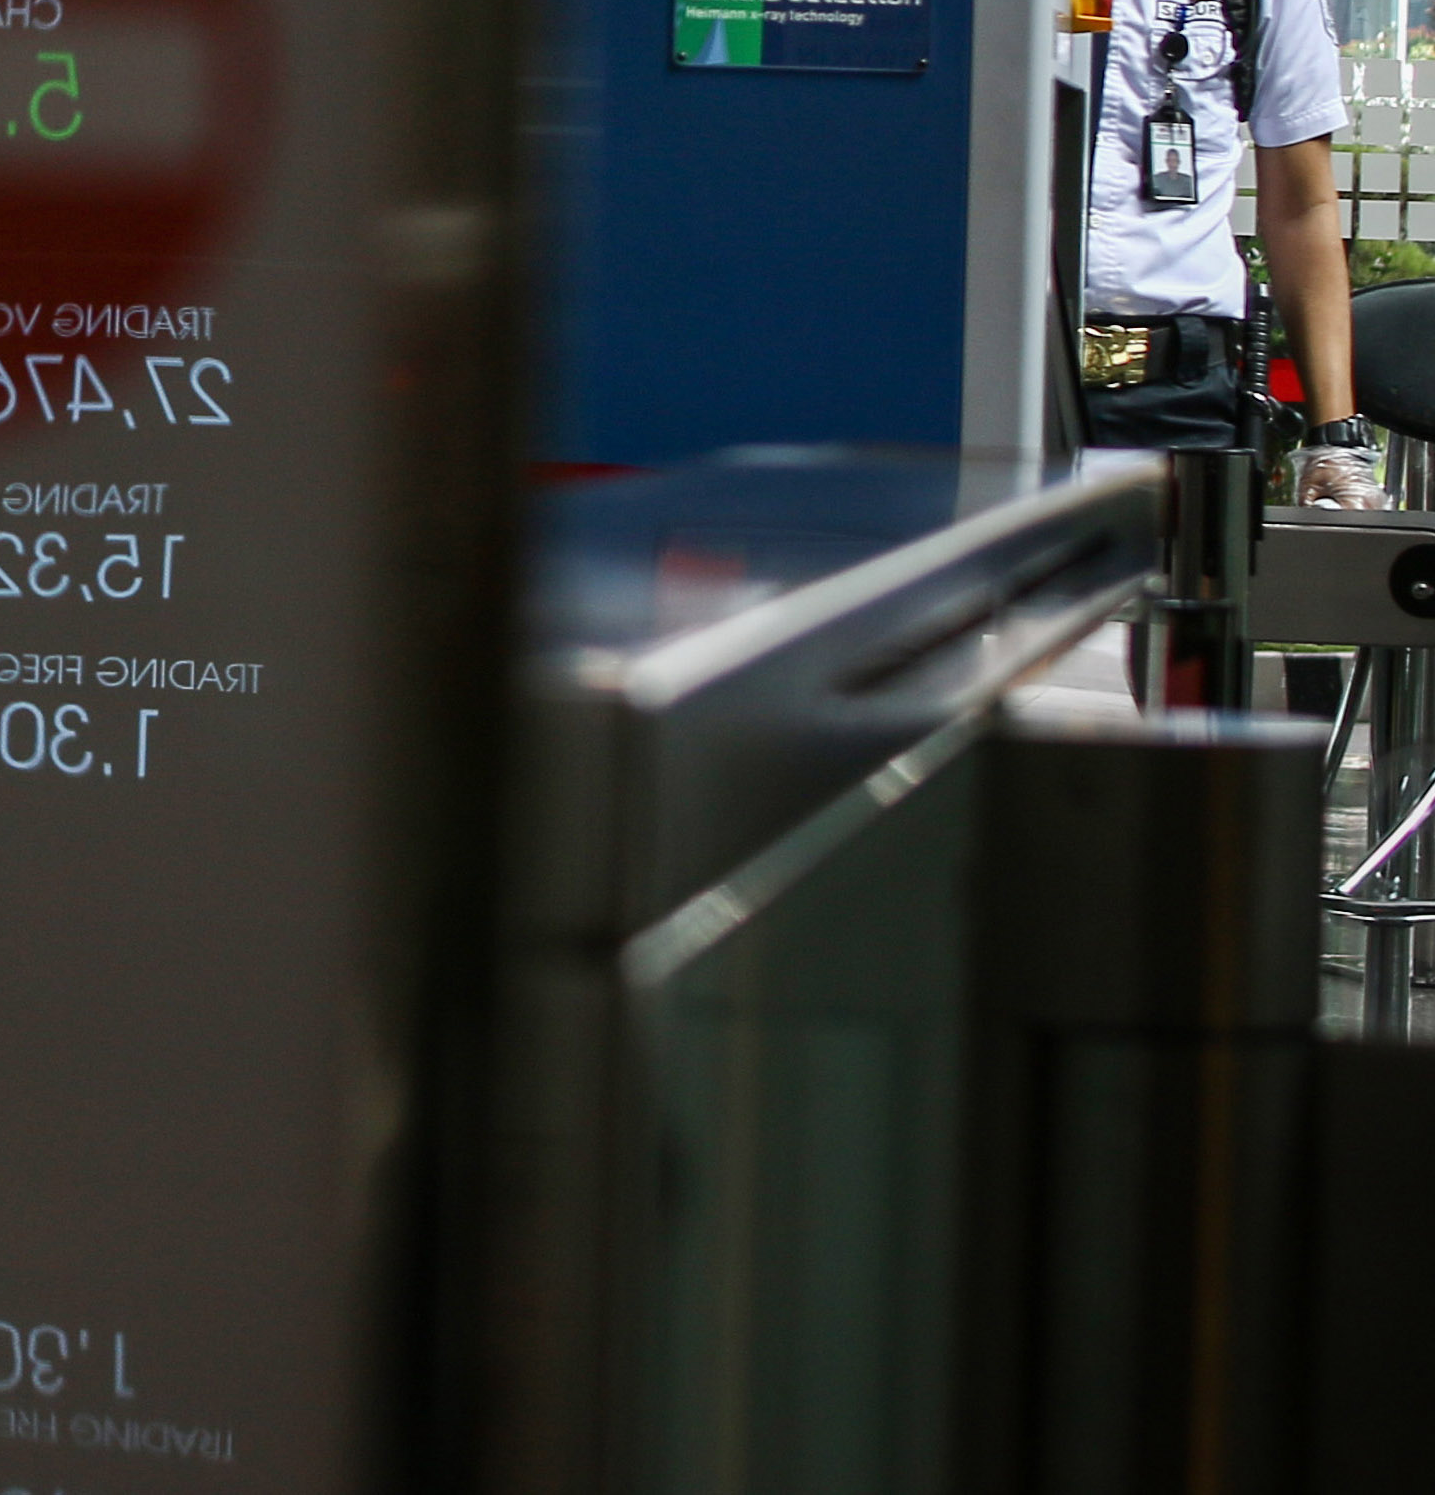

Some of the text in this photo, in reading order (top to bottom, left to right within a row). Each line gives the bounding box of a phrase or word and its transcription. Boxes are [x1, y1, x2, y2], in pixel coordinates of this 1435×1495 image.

[685, 6, 865, 26] Heimann x-ray technology
